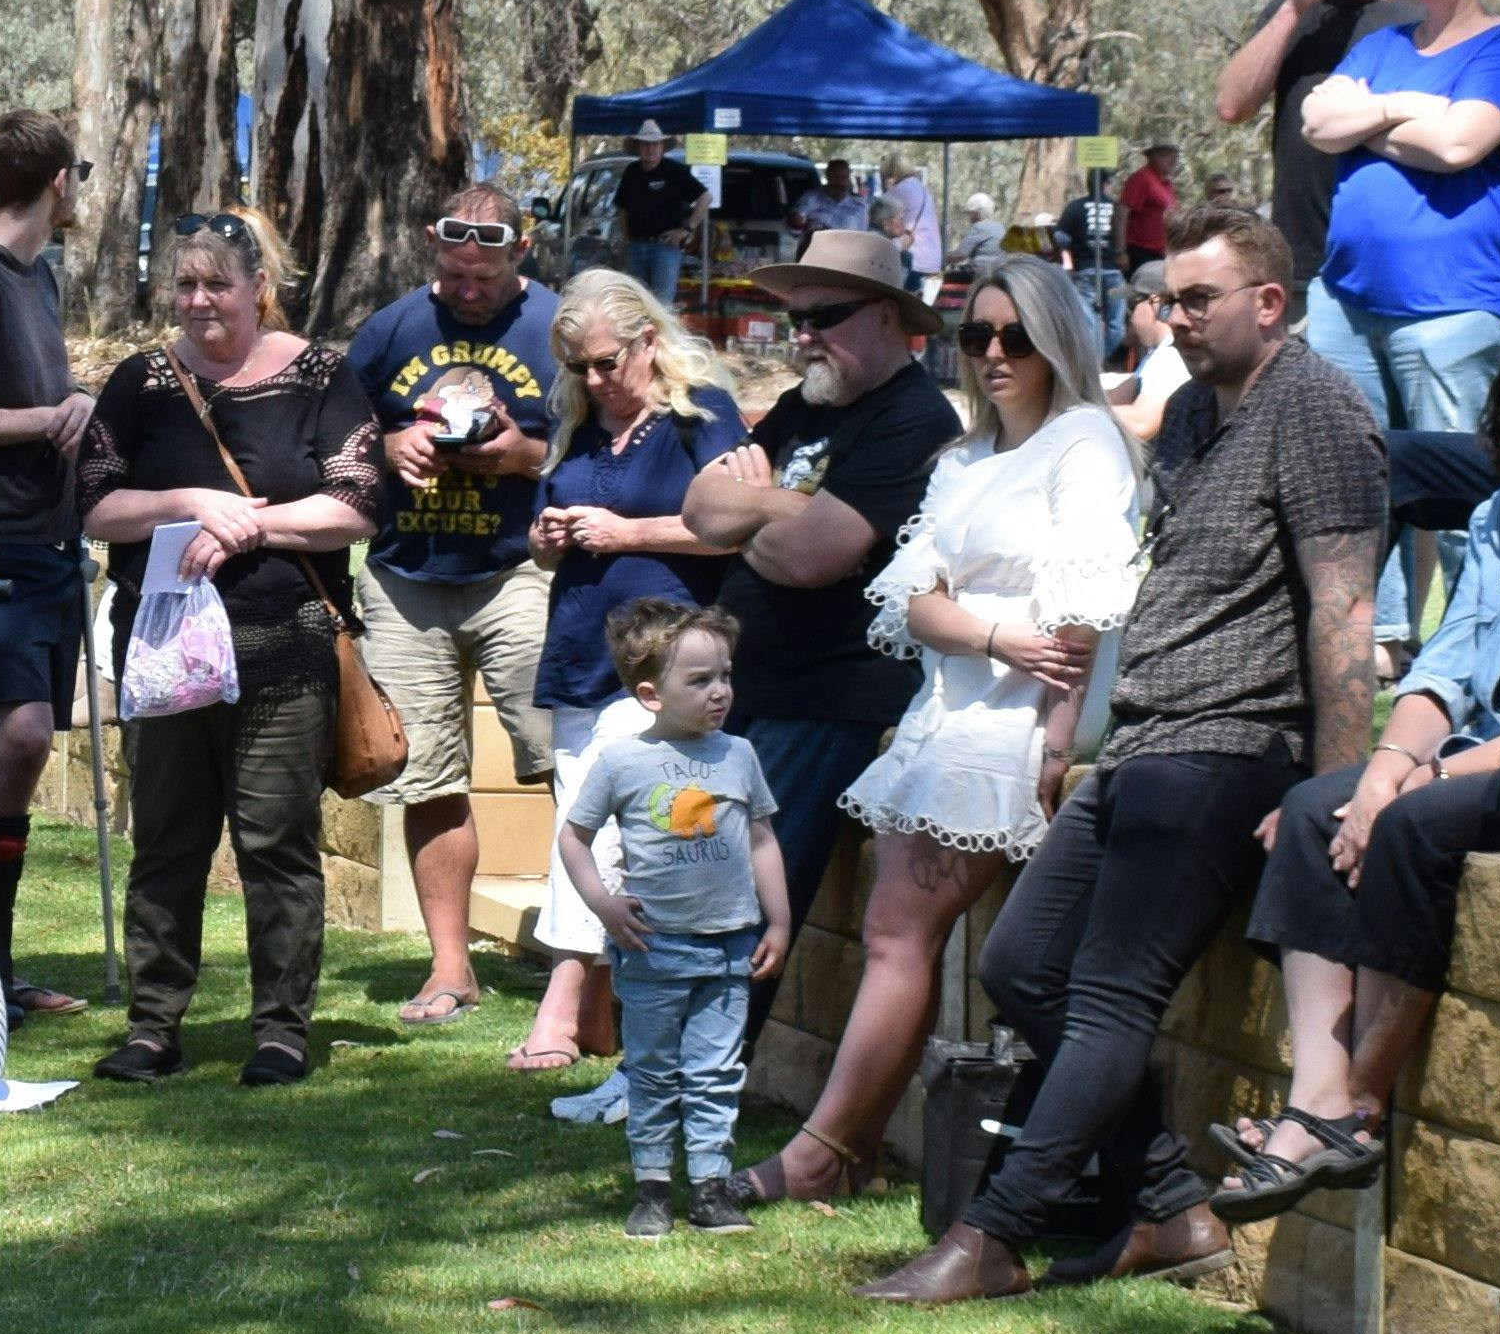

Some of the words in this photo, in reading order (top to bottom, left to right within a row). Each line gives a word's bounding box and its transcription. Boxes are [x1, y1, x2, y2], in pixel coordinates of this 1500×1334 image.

[390, 356, 429, 396] I'M
[430, 341, 542, 398] GRUMPY
[411, 489, 481, 512] YOUR
[396, 511, 501, 535] EXCUSE?
[657, 758, 718, 780] TACO-
[663, 836, 730, 866] SAURUS
